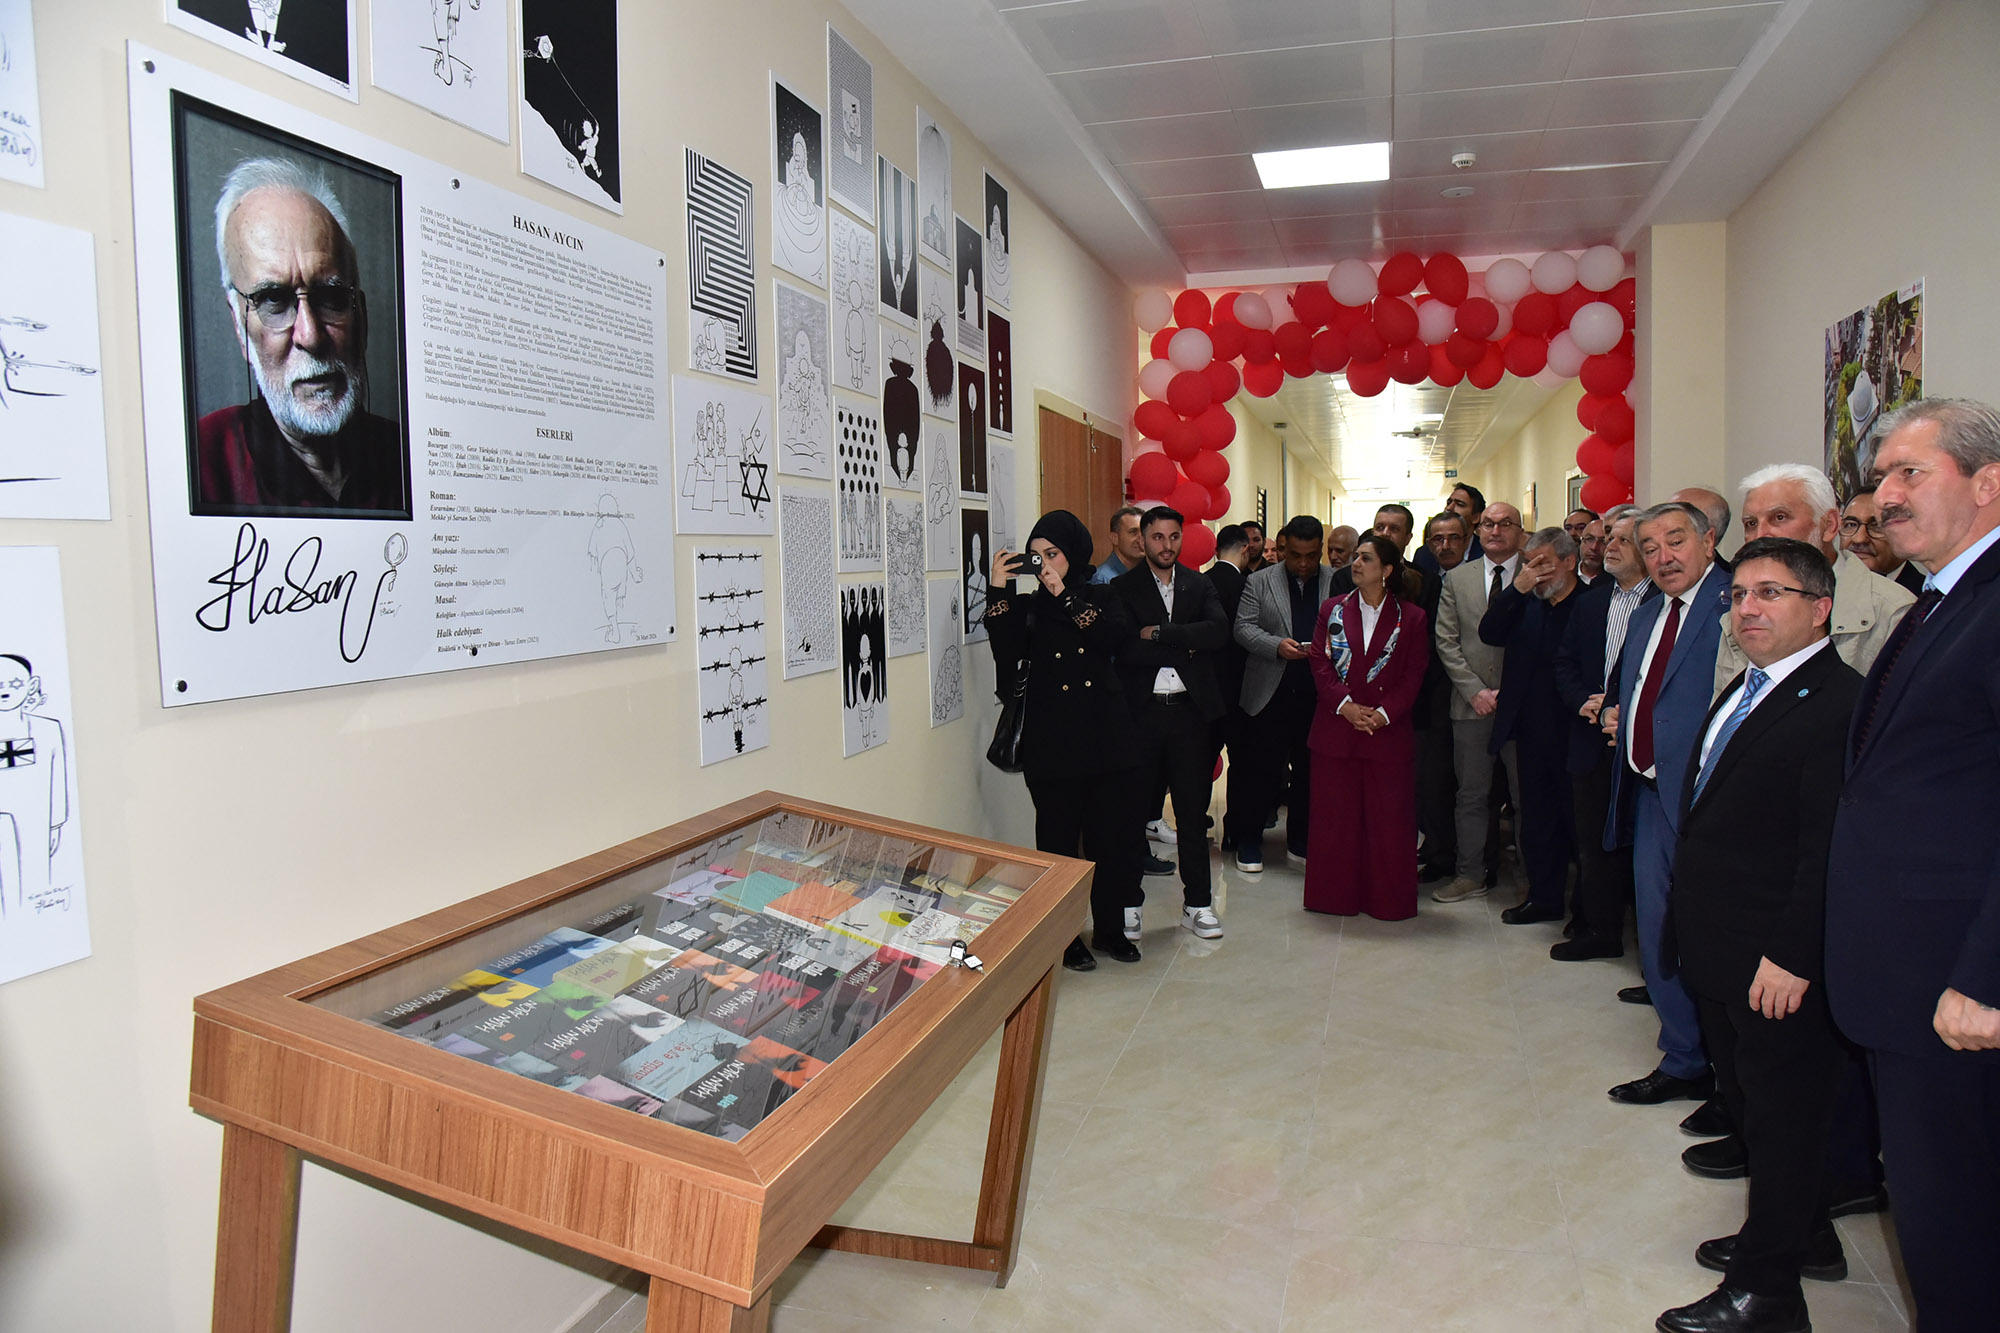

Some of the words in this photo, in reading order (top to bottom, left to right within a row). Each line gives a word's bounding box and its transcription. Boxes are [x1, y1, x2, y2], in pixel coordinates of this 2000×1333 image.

[513, 215, 550, 239] HASAN
[553, 232, 584, 251] AYCIN
[428, 427, 452, 438] Albüm:
[536, 428, 573, 441] ESERLERİ
[430, 491, 456, 500] Roman:
[433, 564, 458, 575] Söyleşi:
[435, 595, 457, 604] Masal:
[437, 629, 452, 638] Halk
